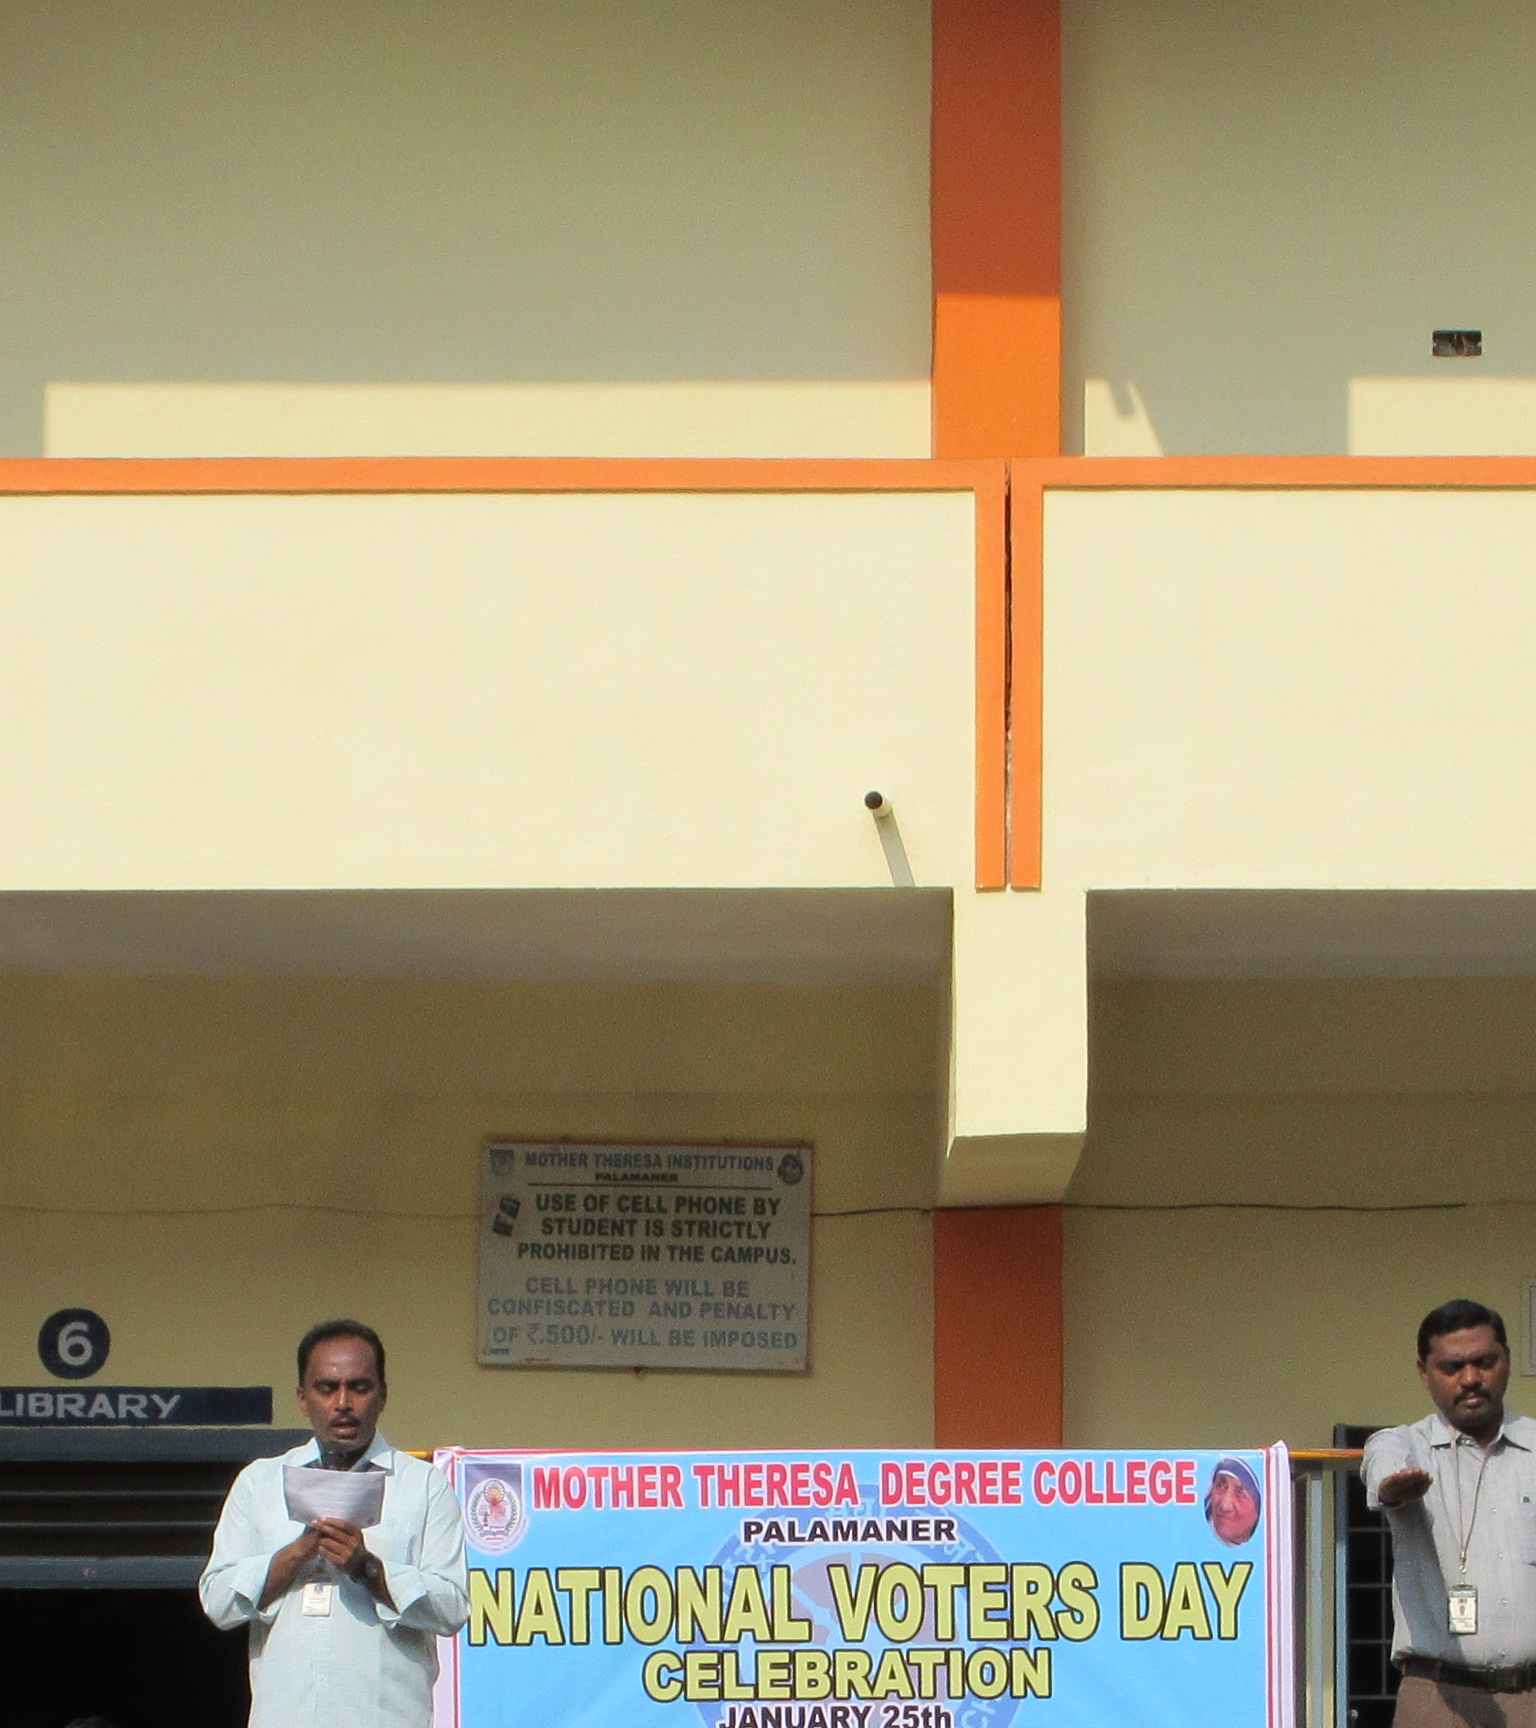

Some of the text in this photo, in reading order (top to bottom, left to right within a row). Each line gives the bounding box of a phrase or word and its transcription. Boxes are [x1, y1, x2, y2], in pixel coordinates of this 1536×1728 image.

[525, 1152, 774, 1171] MOTHER THERESA INSTITUTIONS
[535, 1193, 781, 1216] USE OF CELL PHONE BY
[541, 1217, 771, 1240] STUDENT IS STRICTLY
[517, 1242, 796, 1265] PROHIBITED IN THE CAMPUS.
[525, 1276, 750, 1298] CELL PHONE WILL BE
[487, 1298, 795, 1321] CONFISCATED AND PENALTY
[56, 1321, 93, 1367] 6
[492, 1326, 520, 1343] OF
[611, 1328, 661, 1346] WILL
[667, 1329, 695, 1347] BE
[702, 1331, 798, 1349] IMPOSED
[532, 1461, 1196, 1510] MOTHER THERESA DEGREE COLLEGE
[743, 1519, 957, 1543] PALAMANER
[467, 1562, 1254, 1646] NATIONAL VOTERS DAY
[642, 1646, 1053, 1703] CELEBRATION
